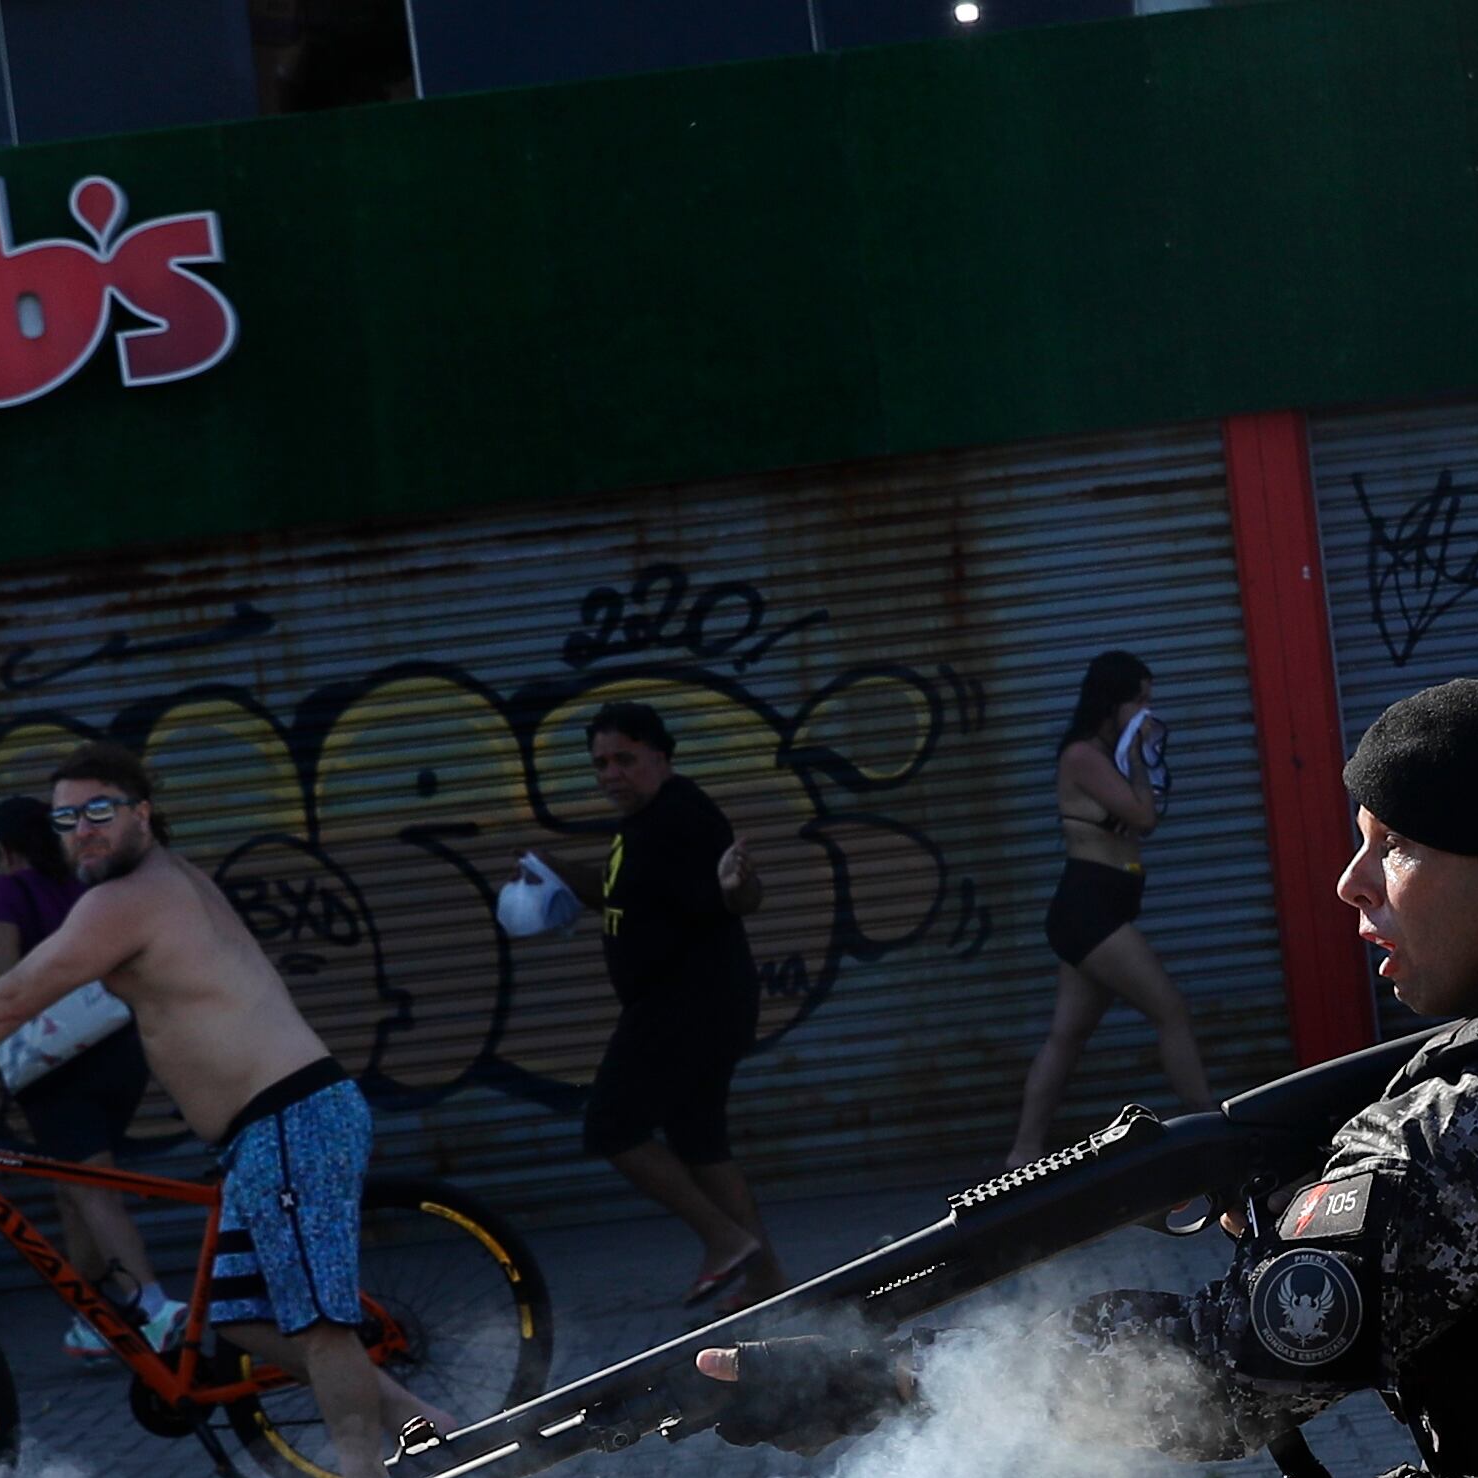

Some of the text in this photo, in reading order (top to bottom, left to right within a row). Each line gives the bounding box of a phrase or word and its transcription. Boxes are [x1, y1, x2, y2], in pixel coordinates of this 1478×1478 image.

[1326, 1189, 1359, 1216] 105
[1293, 1254, 1328, 1267] PMERJ
[1261, 1327, 1296, 1359] RONDAS
